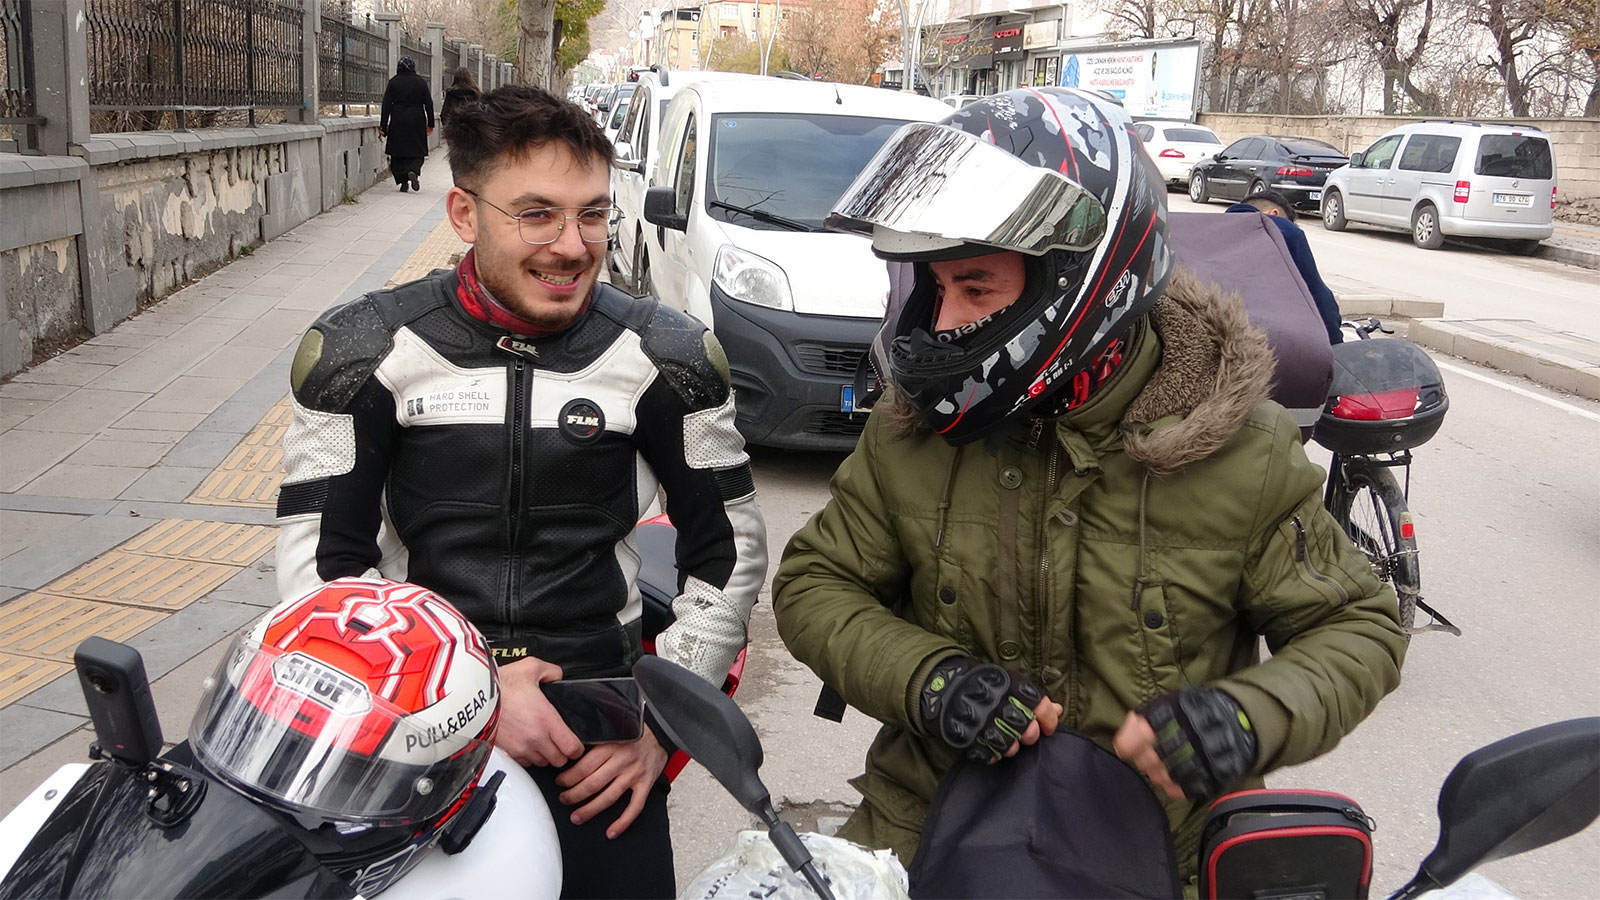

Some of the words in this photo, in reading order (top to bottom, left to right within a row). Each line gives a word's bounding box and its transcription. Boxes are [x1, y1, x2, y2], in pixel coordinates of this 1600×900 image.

[429, 391, 455, 402] HARD
[458, 391, 491, 401] SHELL
[429, 402, 490, 413] PROTECTION
[566, 414, 600, 428] FLM
[491, 647, 528, 658] FLM
[405, 689, 488, 754] PULL&BEAR
